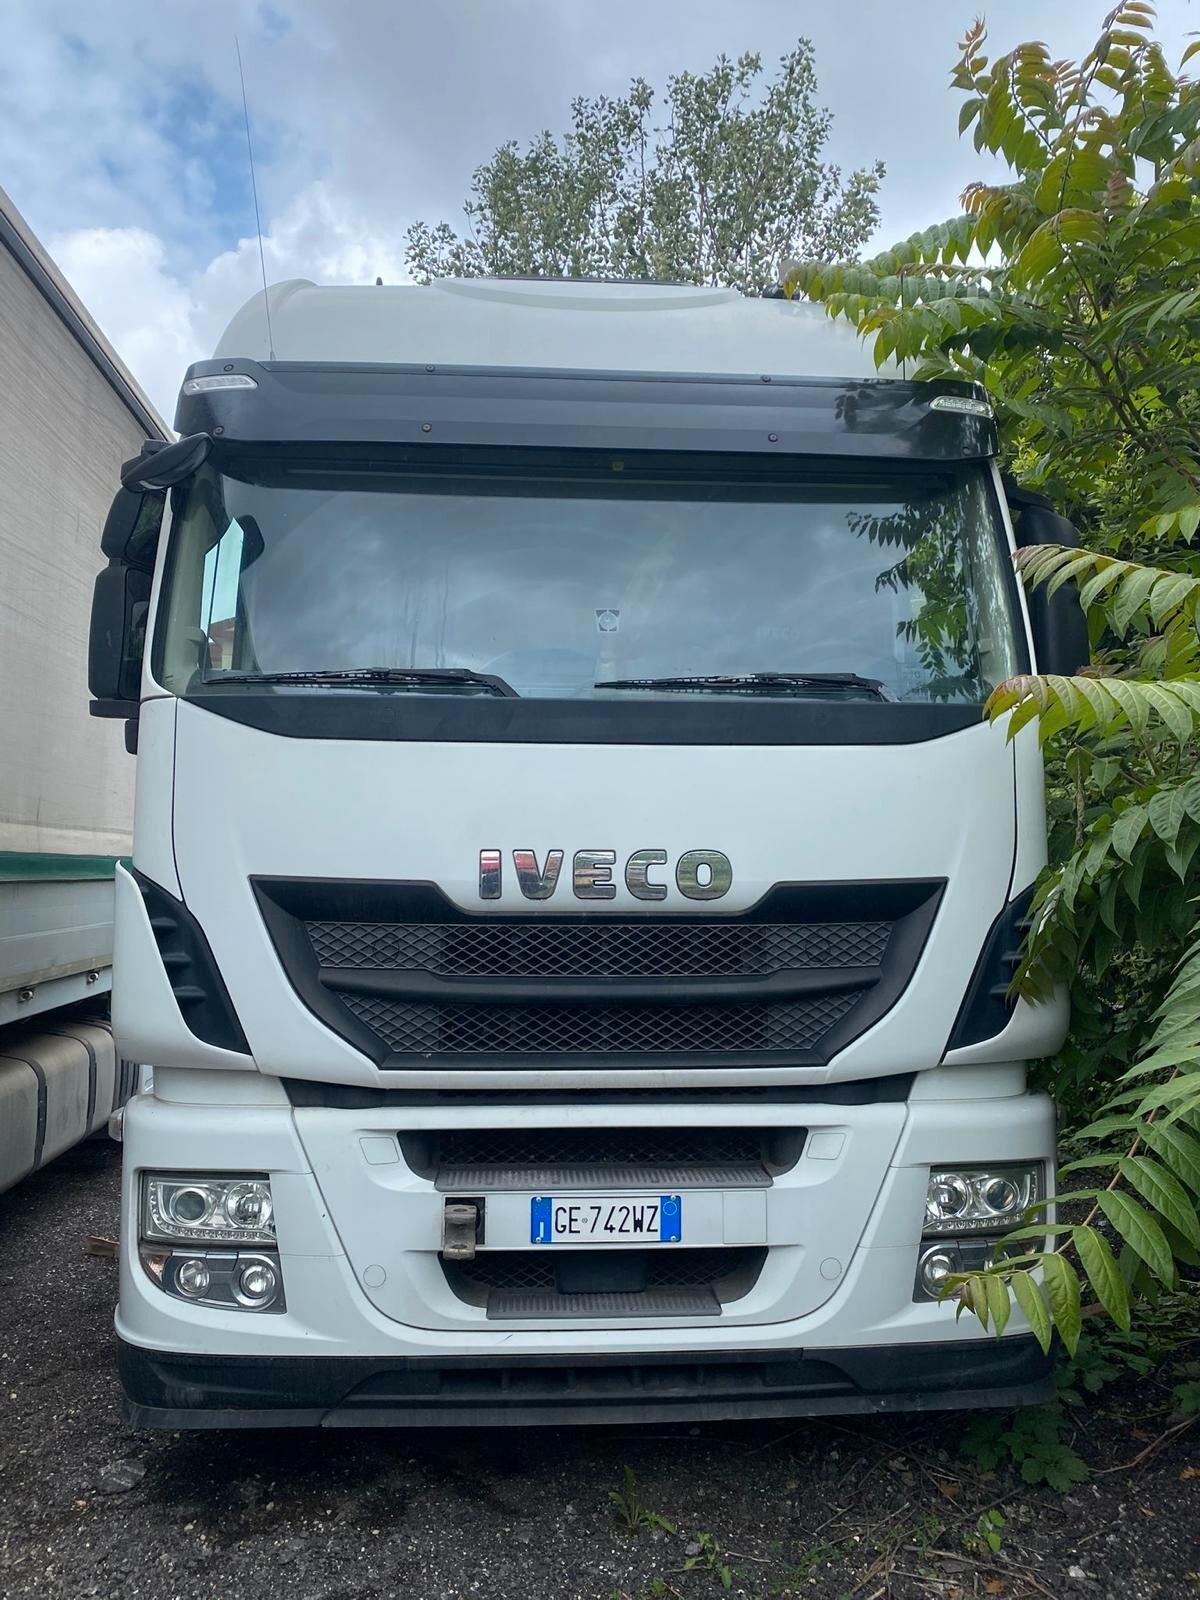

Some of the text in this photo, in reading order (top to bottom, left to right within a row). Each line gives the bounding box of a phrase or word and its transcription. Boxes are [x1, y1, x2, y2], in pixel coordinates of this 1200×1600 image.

[479, 849, 733, 901] IVECO
[554, 1205, 659, 1234] GE 742WZ
